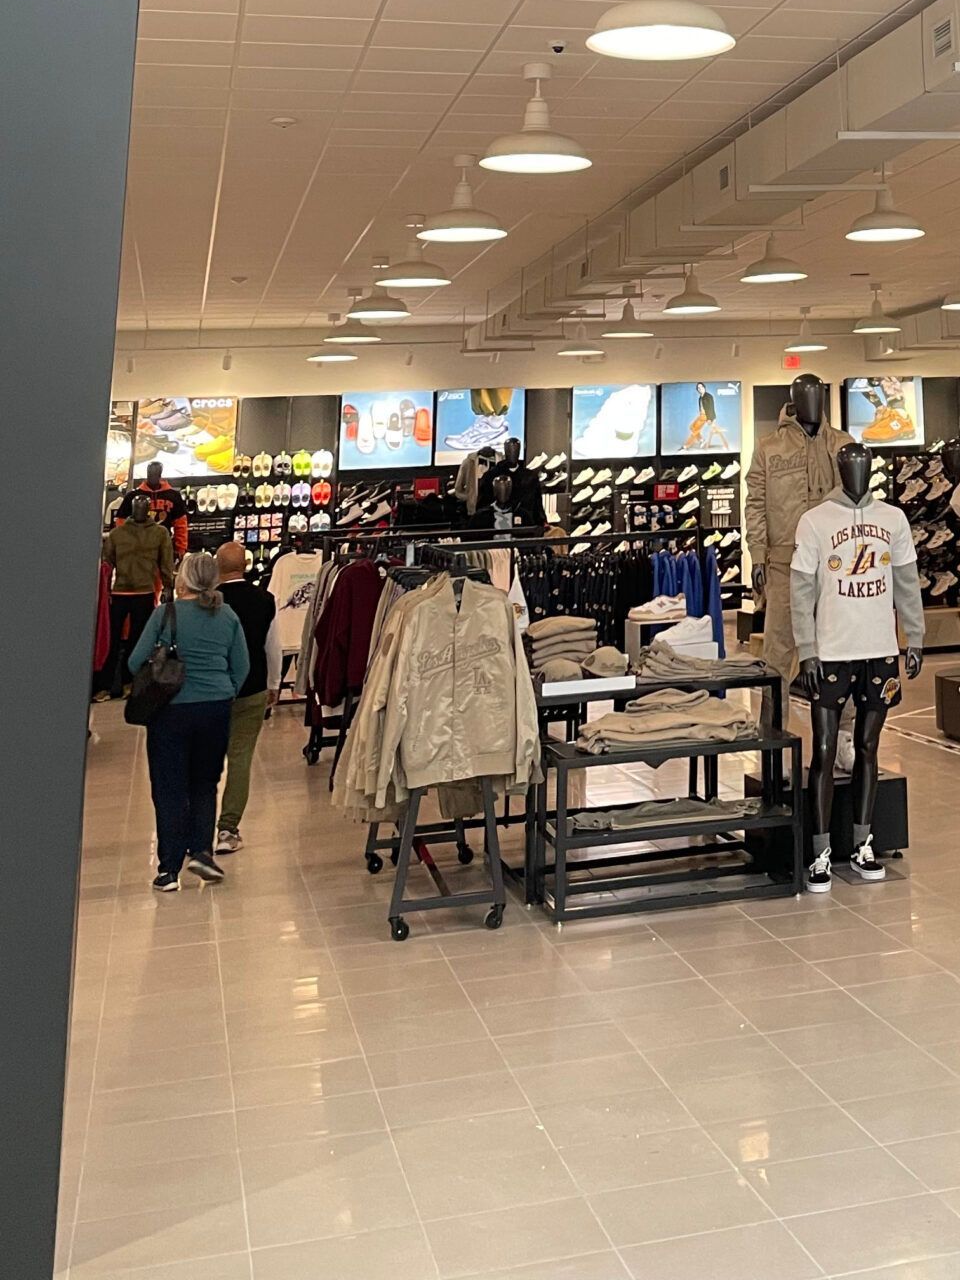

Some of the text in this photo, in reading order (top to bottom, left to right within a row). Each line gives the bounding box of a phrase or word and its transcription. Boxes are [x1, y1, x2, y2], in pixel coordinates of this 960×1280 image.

[192, 398, 234, 409] crocs
[831, 524, 891, 549] LOS ANGELES
[838, 576, 887, 598] LAKERS
